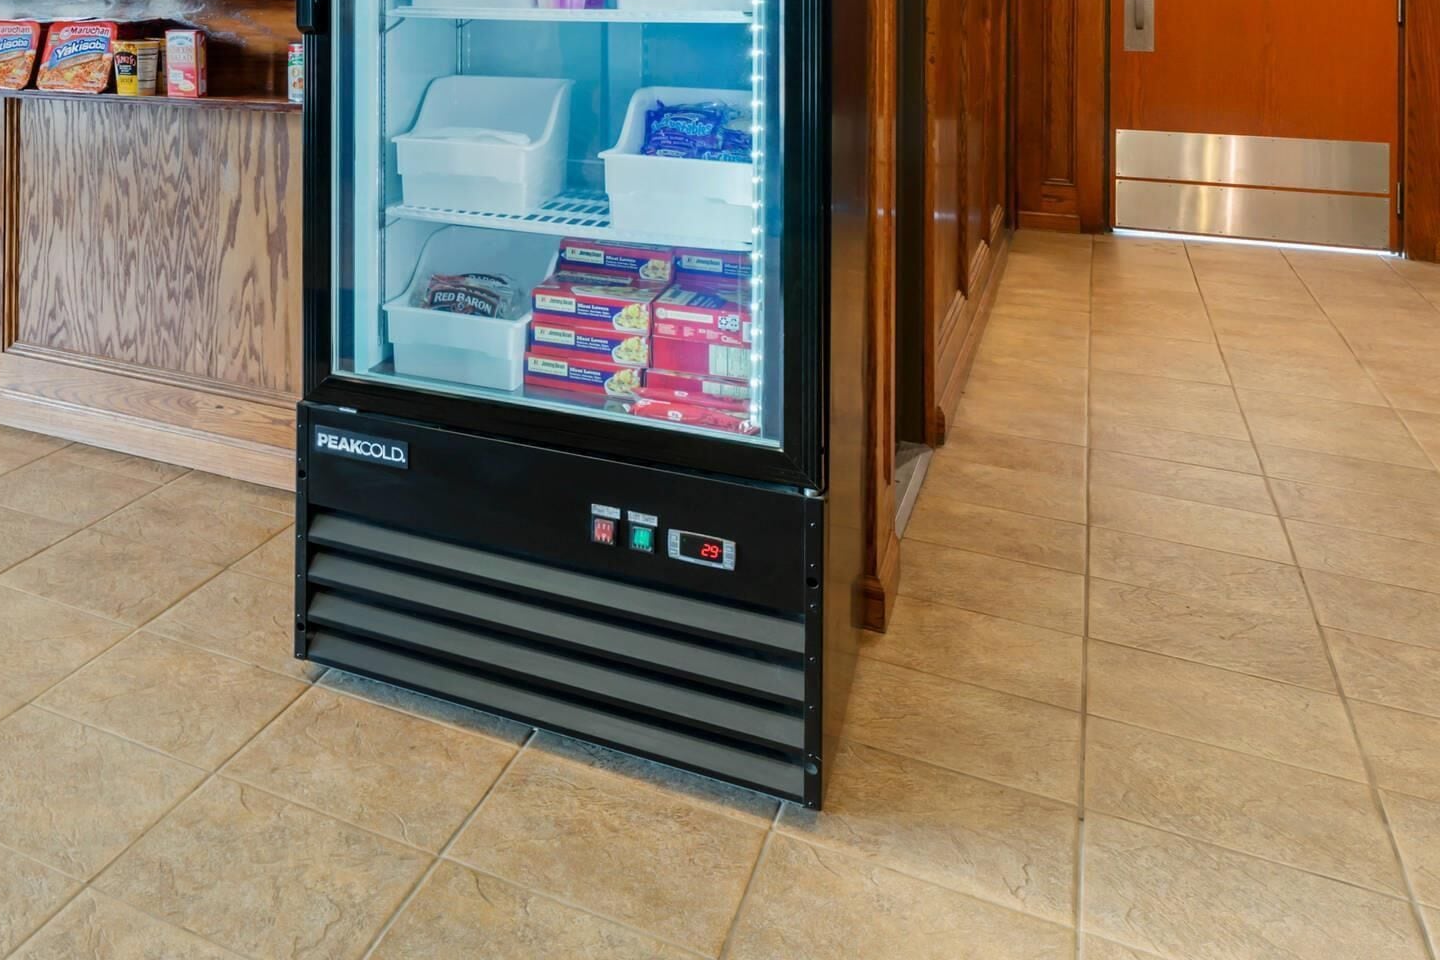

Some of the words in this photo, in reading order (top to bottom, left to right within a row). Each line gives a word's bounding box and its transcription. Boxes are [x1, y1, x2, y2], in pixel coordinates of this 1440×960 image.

[70, 26, 110, 36] Maruchan
[55, 40, 106, 61] Yakisoba
[434, 291, 456, 303] RED
[455, 292, 492, 314] BARON
[701, 543, 719, 559] 29
